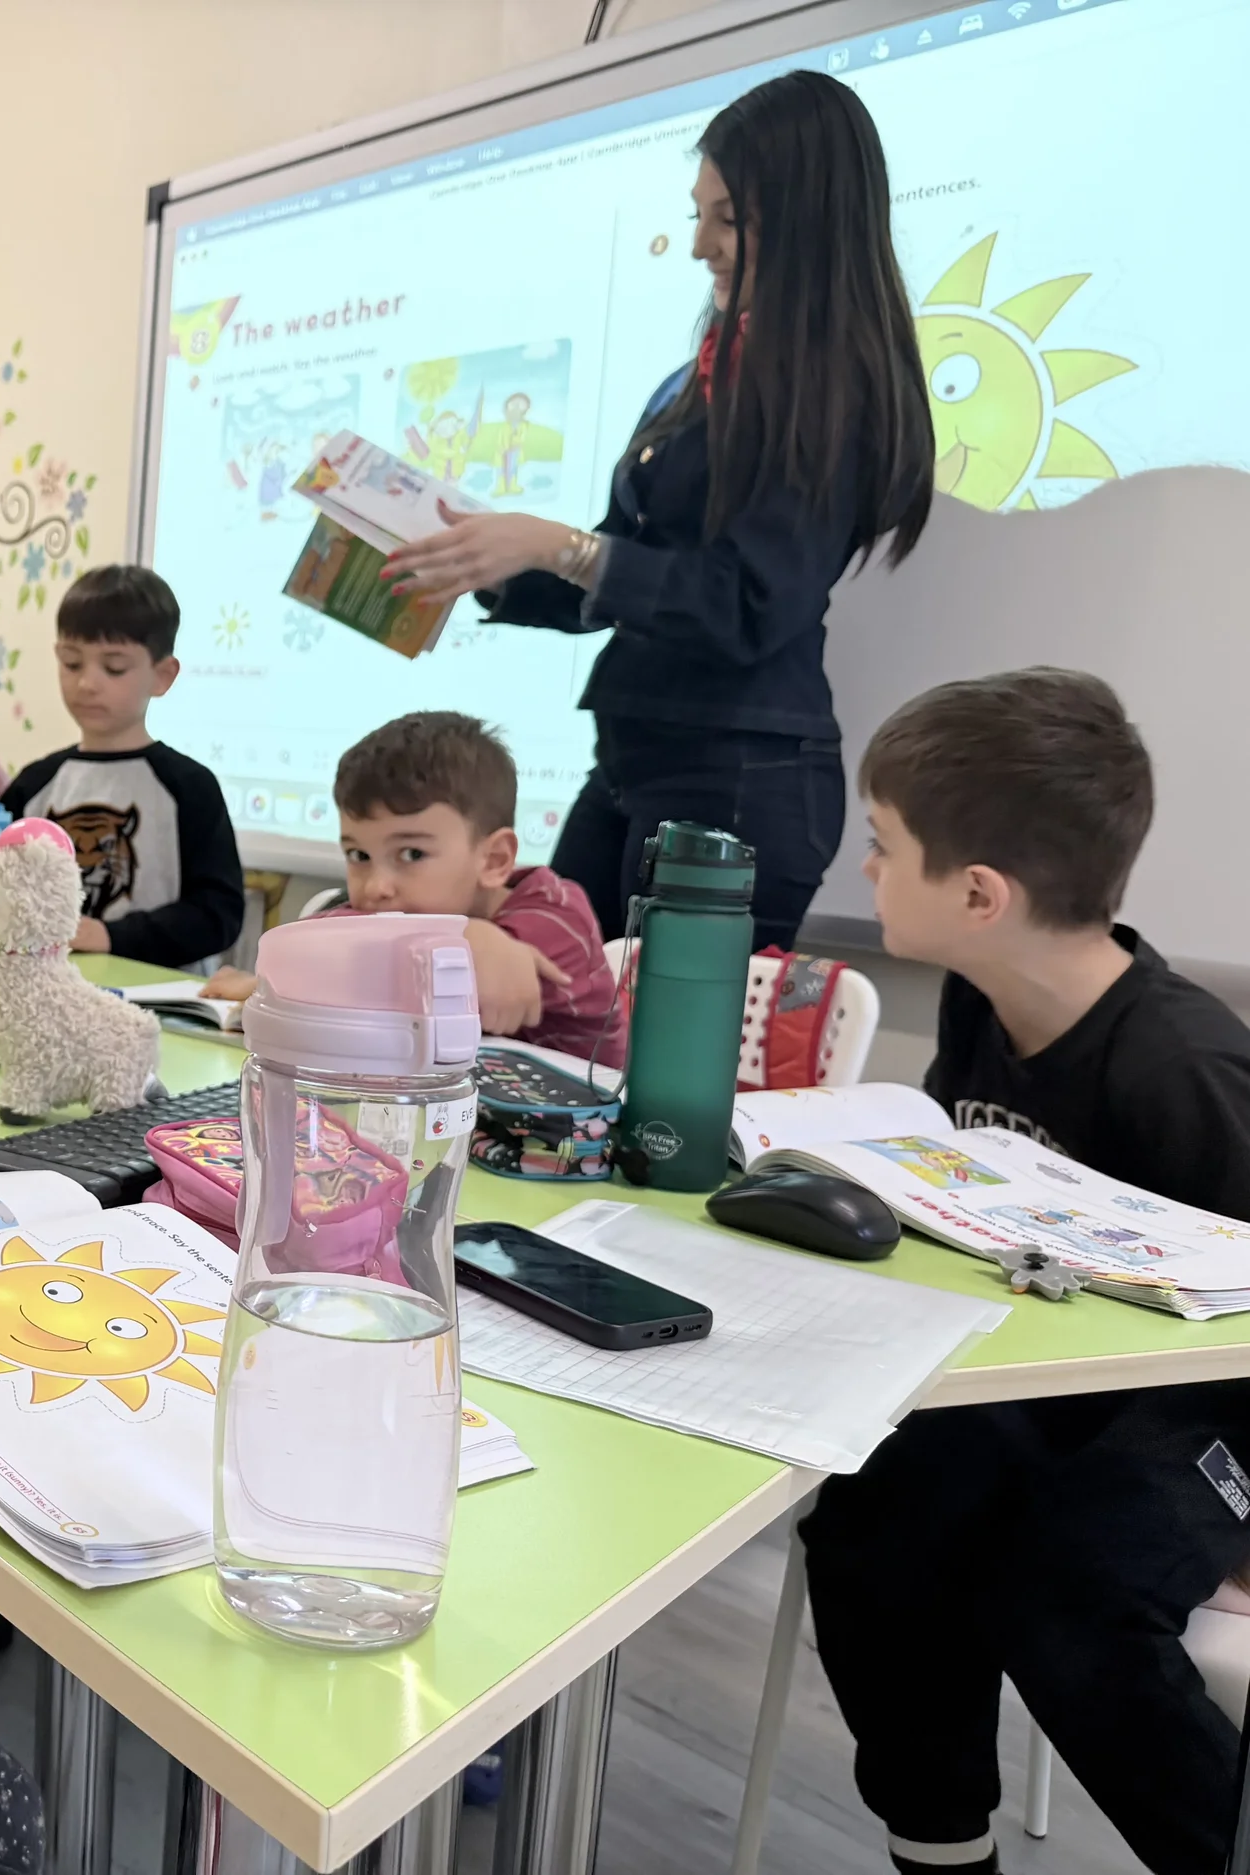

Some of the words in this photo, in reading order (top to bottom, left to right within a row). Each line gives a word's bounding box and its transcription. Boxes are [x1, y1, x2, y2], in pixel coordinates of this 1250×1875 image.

[233, 321, 274, 347] The
[284, 294, 406, 336] weather
[658, 1135, 676, 1146] Free
[141, 1212, 168, 1234] trace.
[168, 1233, 189, 1249] Say
[187, 1248, 205, 1262] the
[203, 1262, 234, 1286] sente
[0, 1465, 8, 1473] it
[5, 1471, 36, 1497] (sunny)?
